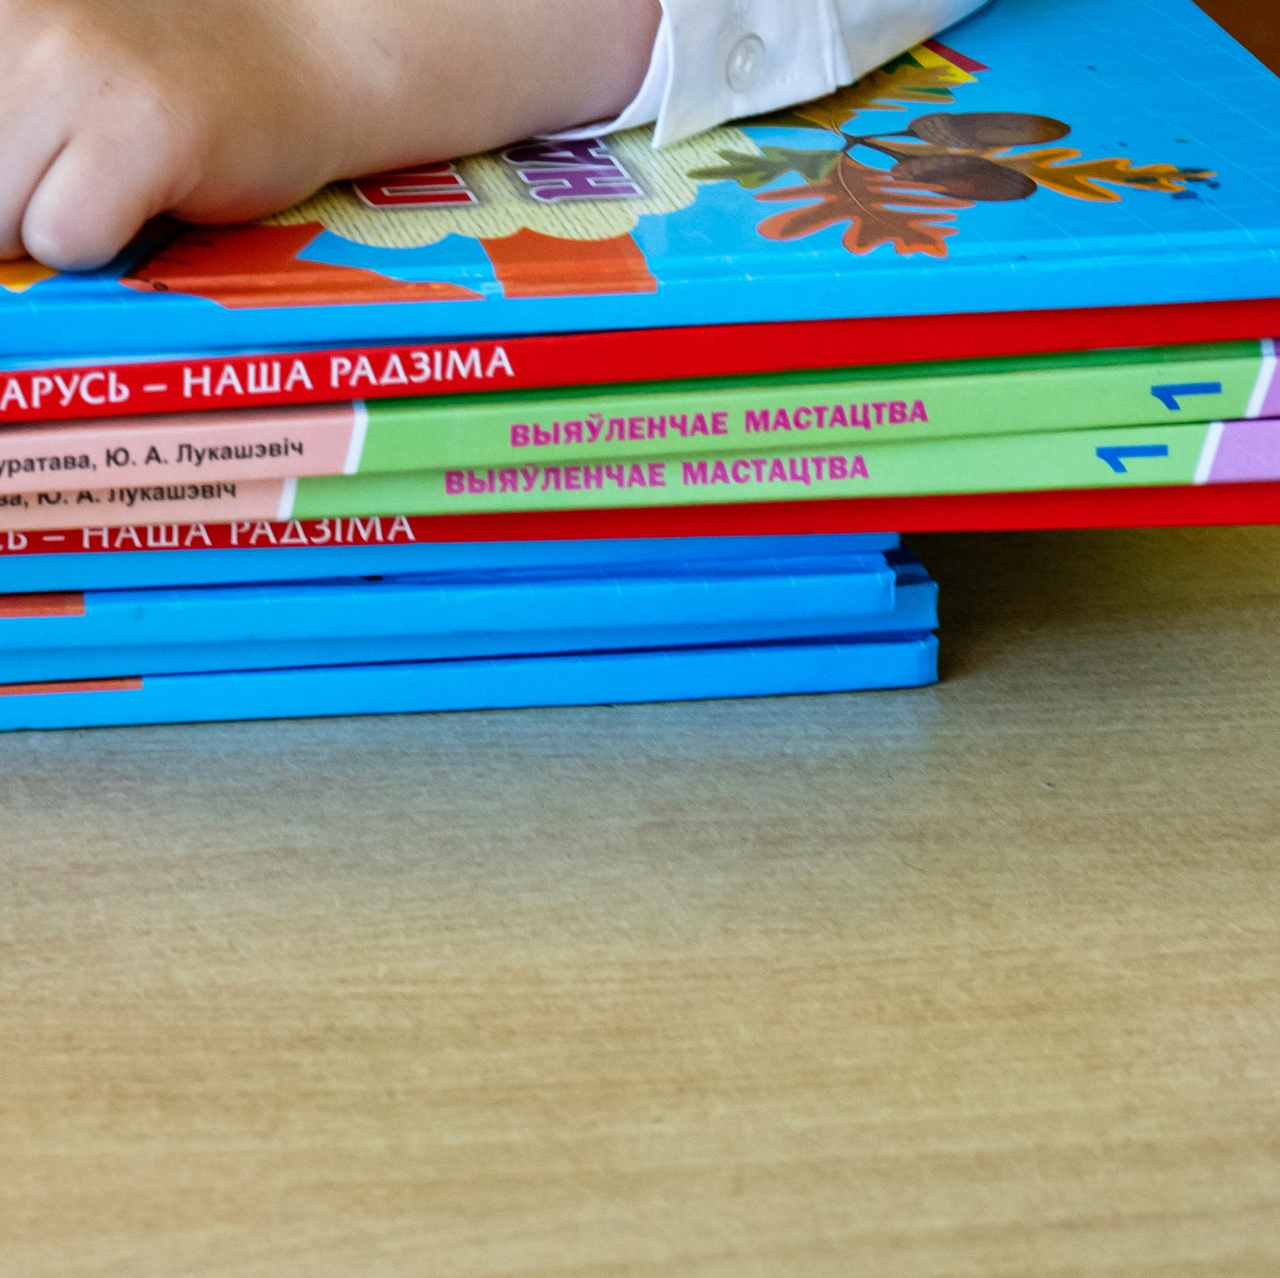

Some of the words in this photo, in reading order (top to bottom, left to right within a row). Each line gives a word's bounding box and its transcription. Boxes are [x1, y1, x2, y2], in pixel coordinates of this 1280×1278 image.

[183, 359, 315, 398] НАША
[330, 346, 516, 388] РАДЗІМА
[1150, 381, 1222, 411] 1
[510, 412, 729, 448] ВЫЯЎЛЕНЧАЕ
[744, 399, 930, 433] МАСТАЦТВА
[105, 446, 137, 468] Ю.
[144, 445, 168, 465] А.
[175, 437, 304, 468] Лукашэвіч
[1095, 444, 1169, 473] 1
[444, 462, 666, 495] ВЫЯЎЛЕНЧАЕ
[681, 454, 870, 486] МАСТАЦТВА
[81, 522, 213, 549] НАША
[229, 515, 417, 546] РАДЗІМА
